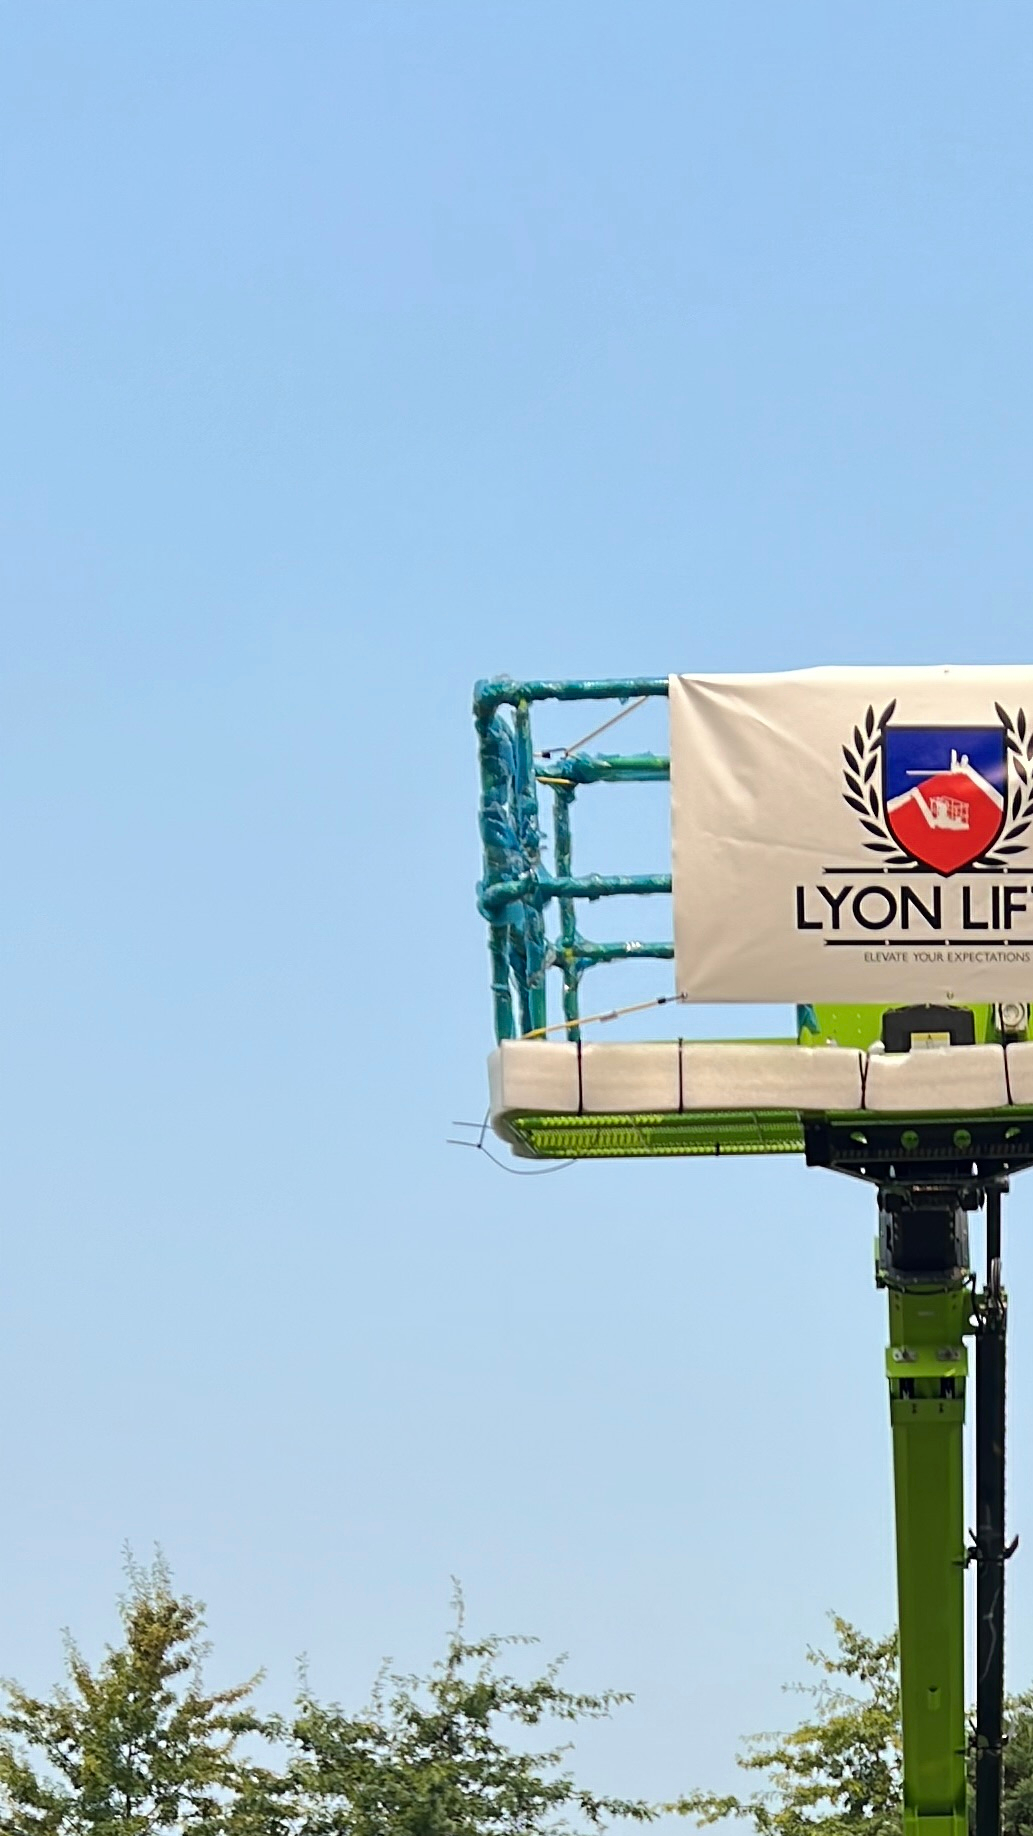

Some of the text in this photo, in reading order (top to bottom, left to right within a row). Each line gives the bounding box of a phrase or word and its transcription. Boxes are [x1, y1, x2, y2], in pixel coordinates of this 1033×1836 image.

[797, 886, 941, 931] LYON
[864, 951, 1031, 963] ELEVATE YOUR EXPECTATIONS
